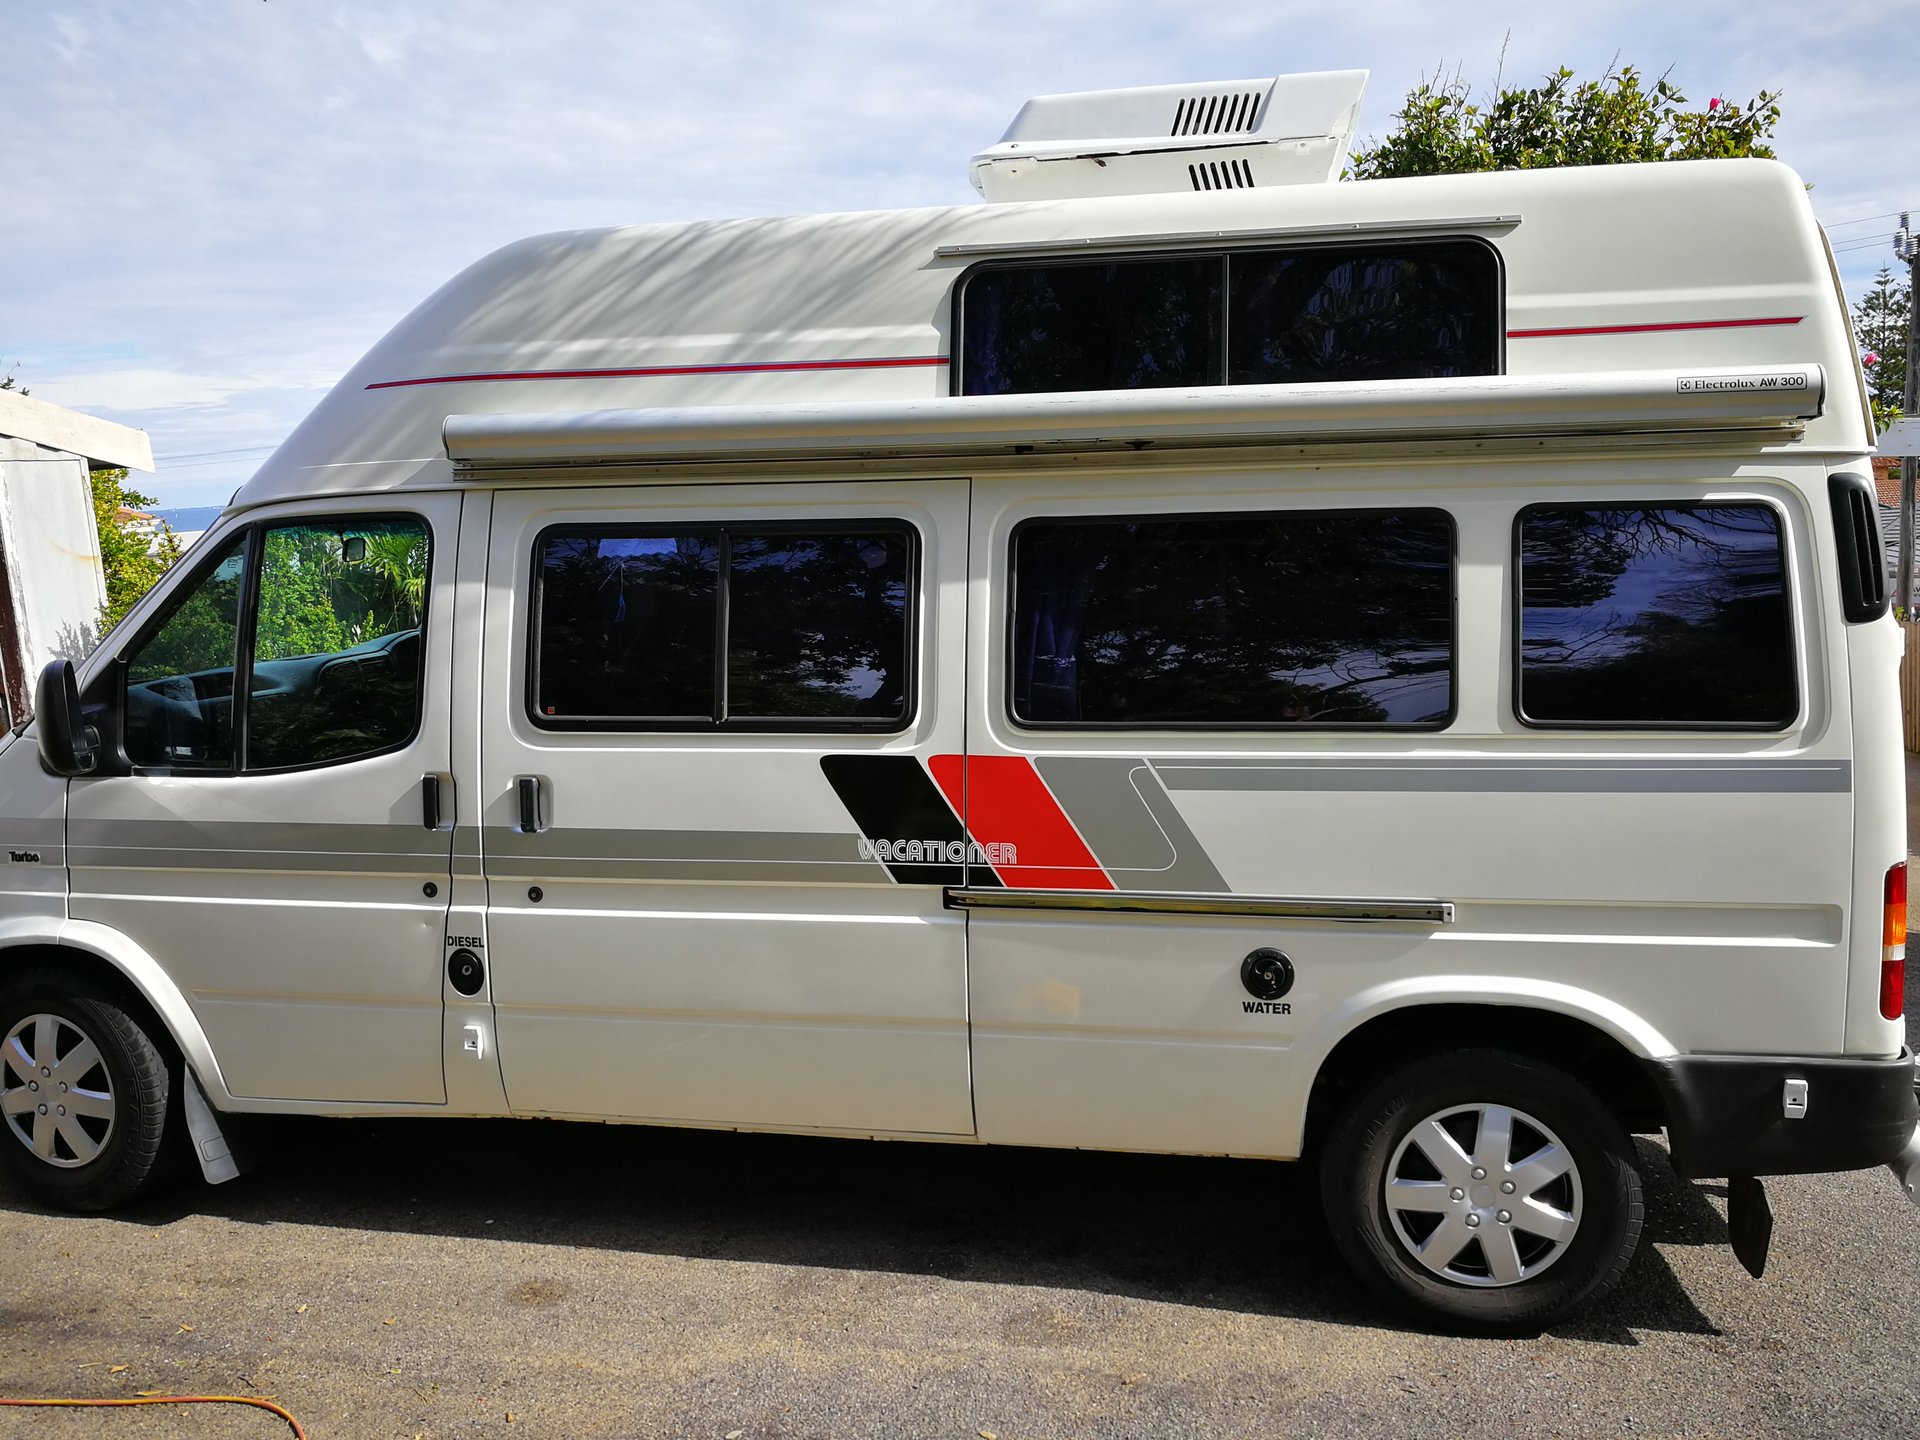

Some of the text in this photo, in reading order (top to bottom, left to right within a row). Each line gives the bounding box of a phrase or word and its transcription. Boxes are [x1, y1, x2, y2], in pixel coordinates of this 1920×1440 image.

[1694, 376, 1804, 390] Electrolux AW 300
[8, 850, 40, 863] Turbo
[857, 838, 1017, 865] VACATIONER
[447, 935, 485, 948] DIESEL
[1242, 1001, 1291, 1015] WATER
